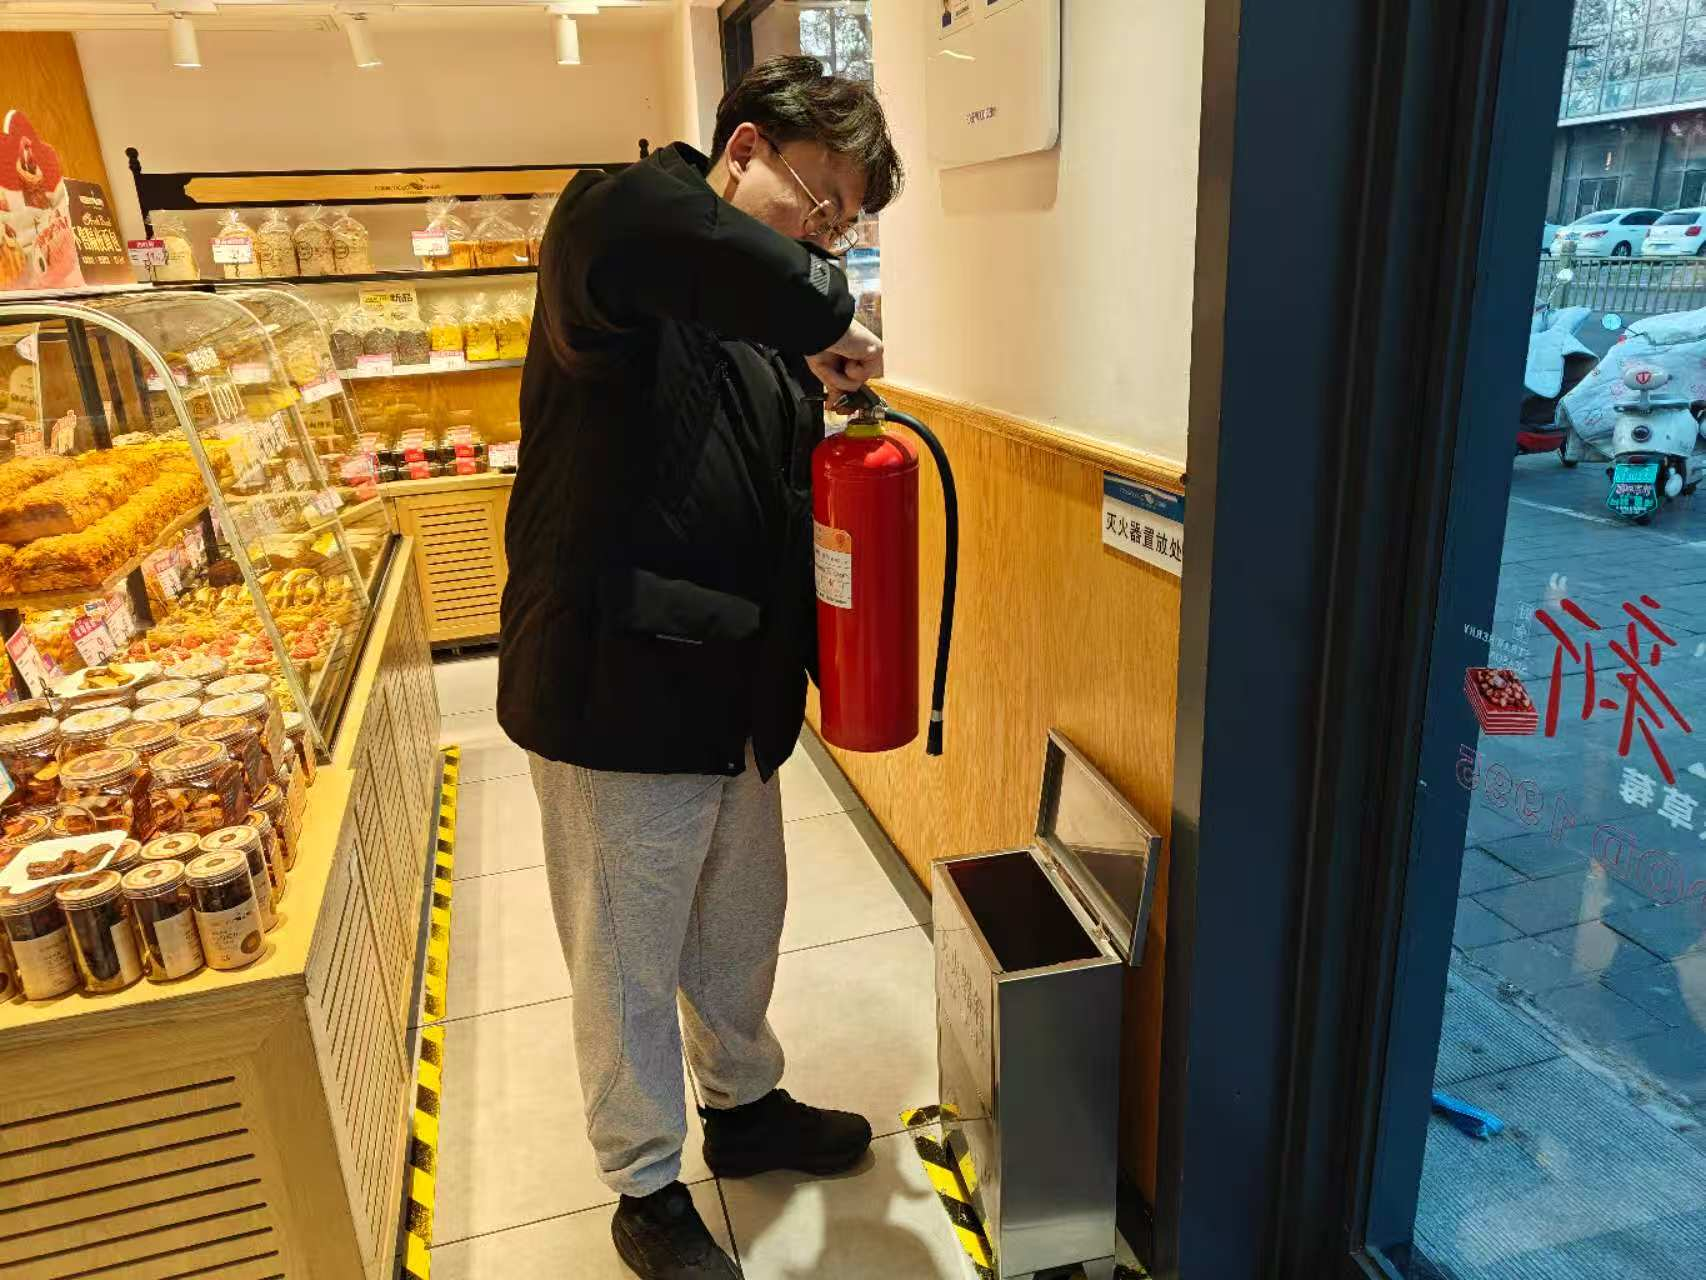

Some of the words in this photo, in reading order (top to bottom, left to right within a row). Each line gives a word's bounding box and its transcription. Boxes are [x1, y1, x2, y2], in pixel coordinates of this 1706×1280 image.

[1106, 511, 1183, 562] 灭火器置放处
